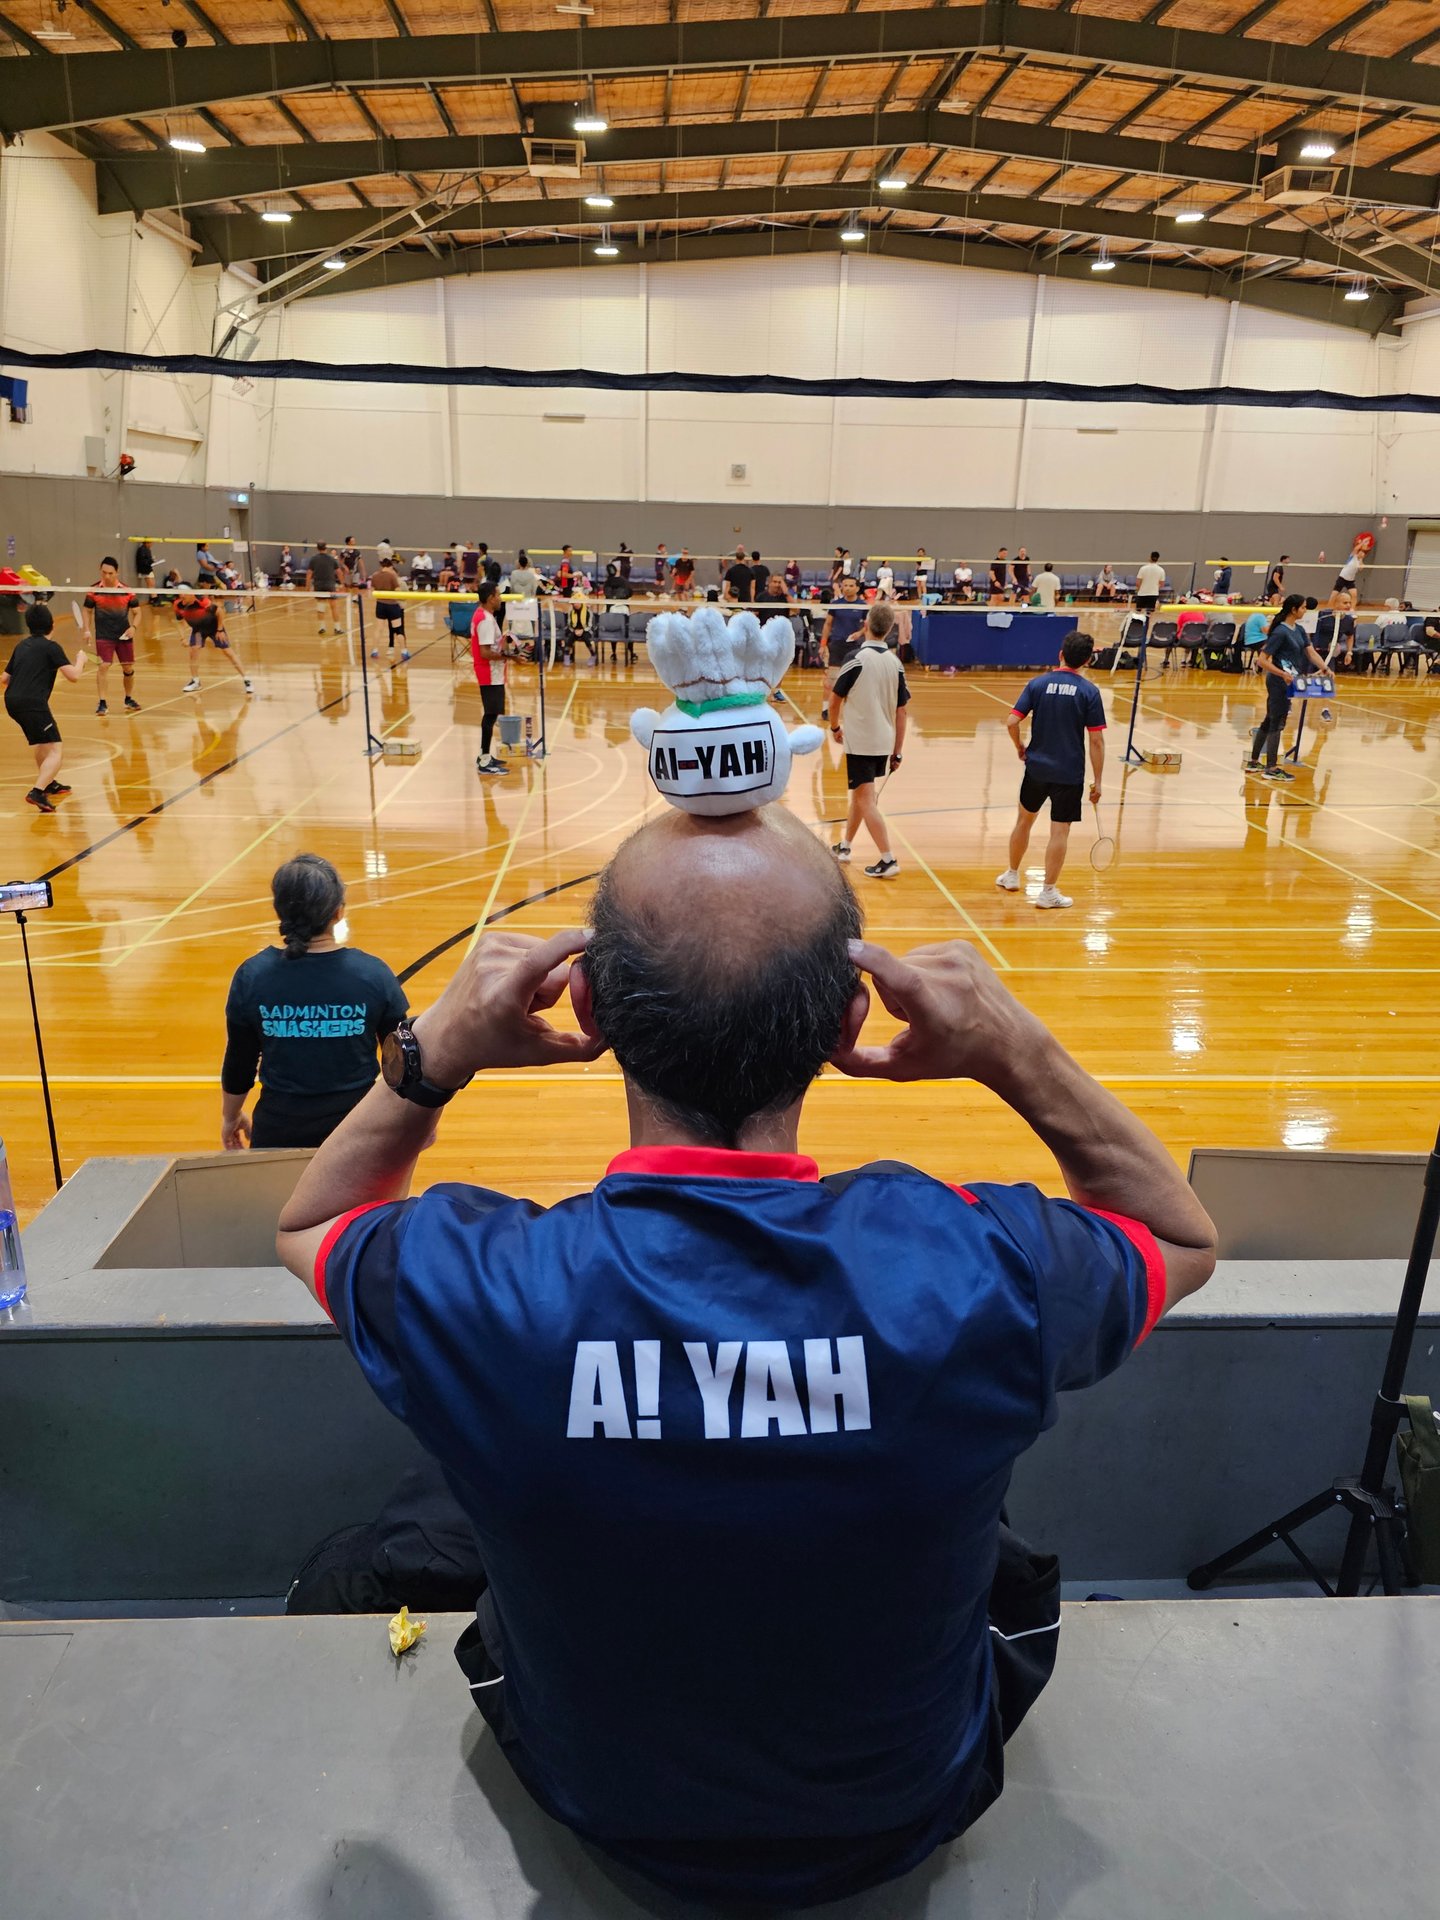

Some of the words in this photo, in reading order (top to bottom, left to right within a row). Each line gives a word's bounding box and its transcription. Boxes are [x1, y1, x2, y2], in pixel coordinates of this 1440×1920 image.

[1058, 684, 1077, 696] YAH
[259, 1003, 366, 1019] BADMINTON
[262, 1019, 365, 1037] SMASHERS
[566, 1340, 661, 1439] A!
[682, 1335, 871, 1439] YAH
